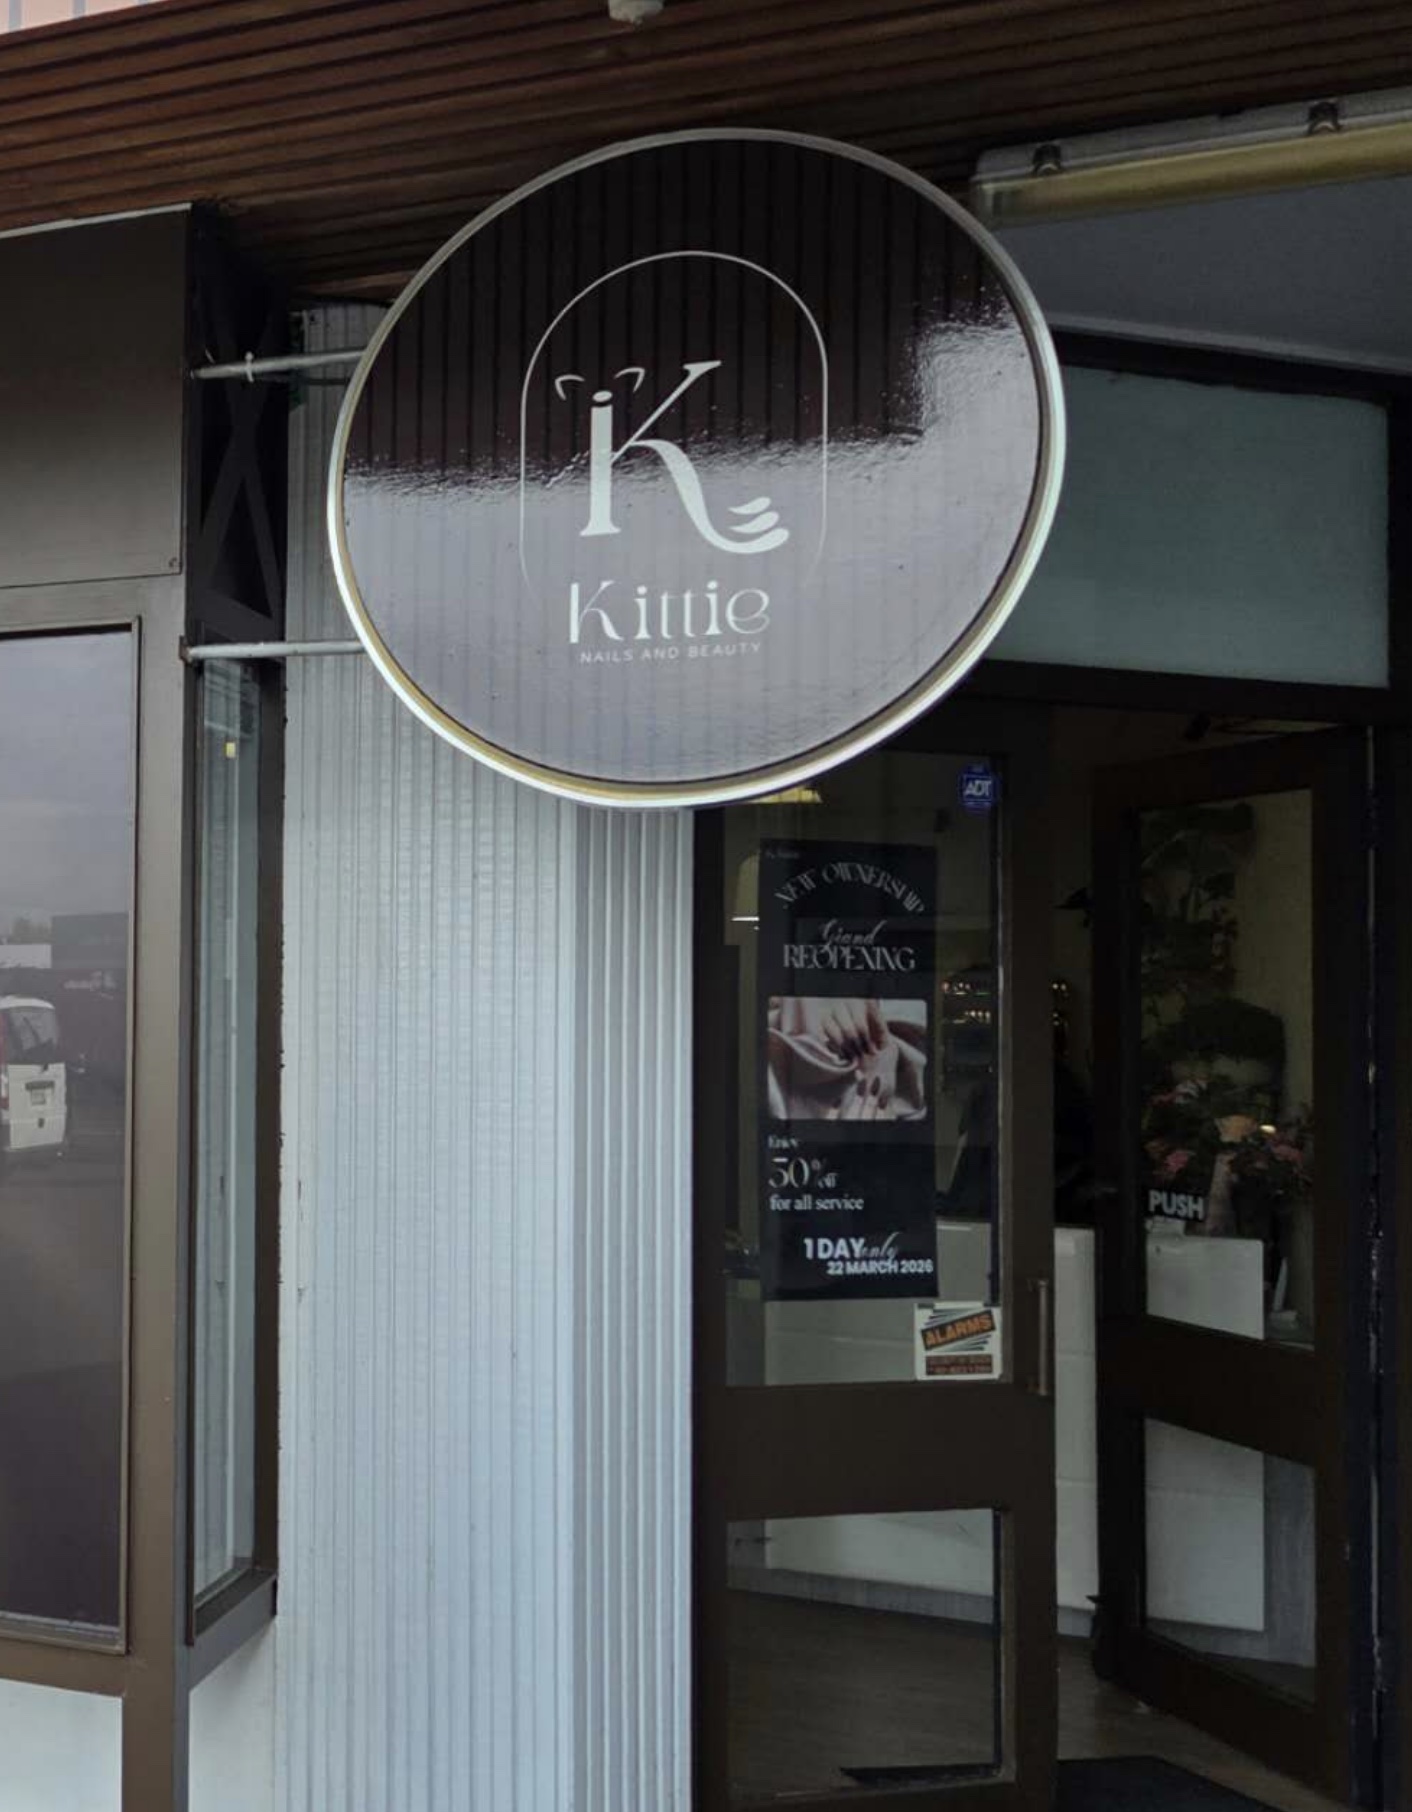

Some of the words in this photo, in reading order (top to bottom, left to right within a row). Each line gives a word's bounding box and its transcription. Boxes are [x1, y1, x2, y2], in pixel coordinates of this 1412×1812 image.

[569, 579, 771, 643] Kittie
[580, 650, 633, 663] NAILS
[641, 647, 679, 660] AND
[688, 641, 762, 658] BEAUTY
[964, 779, 992, 796] ADT
[821, 861, 926, 913] OWNERSHIP
[822, 919, 888, 953] Grand
[782, 944, 916, 971] REOPENING
[769, 1194, 792, 1211] for
[794, 1195, 813, 1211] all
[815, 1194, 865, 1211] service
[1148, 1189, 1205, 1220] PUSH
[803, 1238, 815, 1260] 1
[818, 1237, 866, 1259] DAY
[826, 1260, 845, 1276] 22
[846, 1259, 898, 1274] MARCH
[900, 1258, 935, 1275] 2026
[925, 1313, 992, 1347] ALARMS
